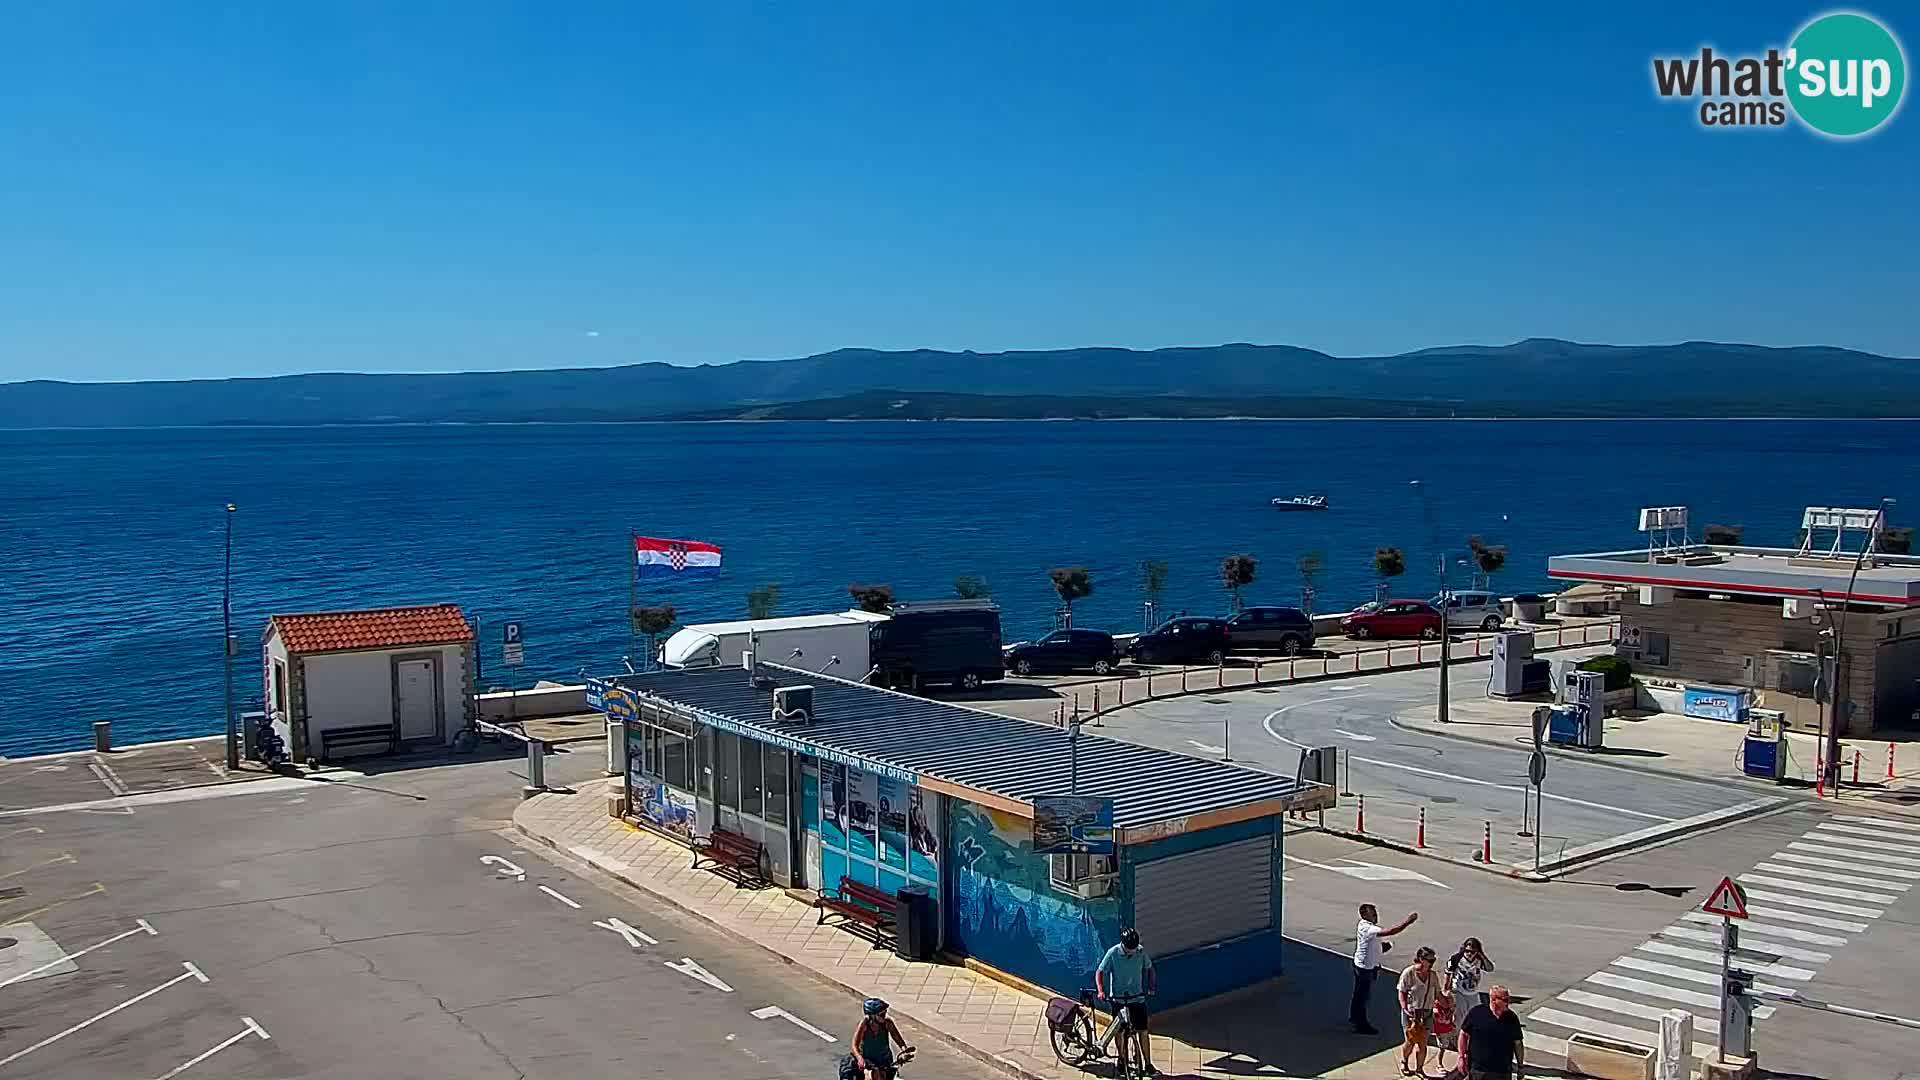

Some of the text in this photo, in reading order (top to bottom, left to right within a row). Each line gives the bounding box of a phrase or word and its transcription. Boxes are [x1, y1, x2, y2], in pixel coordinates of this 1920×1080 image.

[507, 624, 518, 641] P
[776, 736, 806, 752] POSTAJA
[815, 747, 829, 758] BUS
[830, 751, 860, 768] STATION
[862, 760, 887, 775] TICKET
[887, 769, 913, 782] OFFICE
